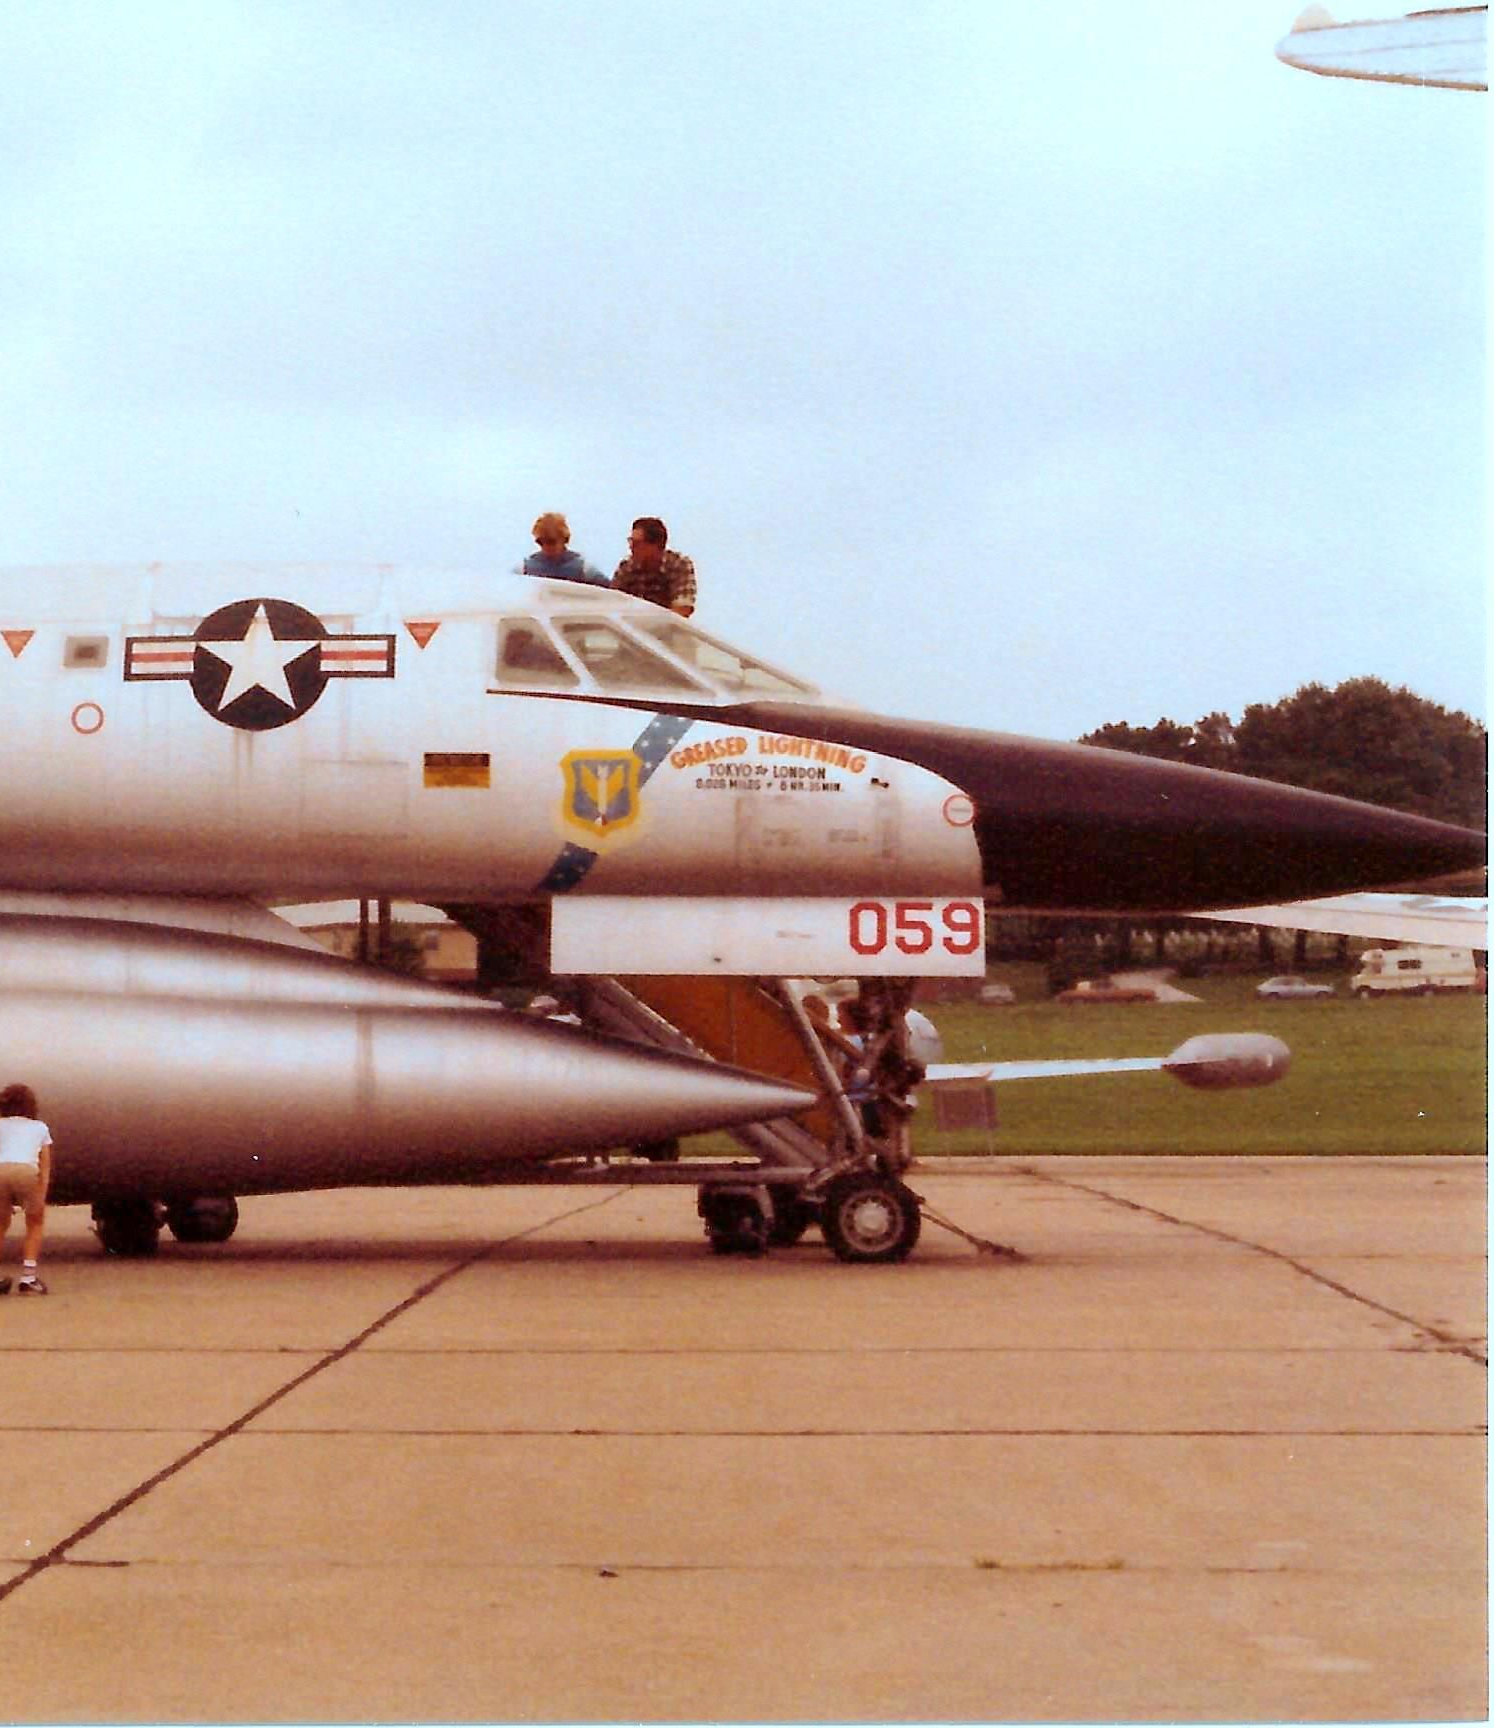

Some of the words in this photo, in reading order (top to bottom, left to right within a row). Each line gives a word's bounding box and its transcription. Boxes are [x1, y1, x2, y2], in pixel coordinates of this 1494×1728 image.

[670, 737, 748, 769] GREASED
[759, 736, 867, 773] LIGHTNING
[708, 763, 752, 779] TOKYO
[773, 765, 826, 780] LONDON
[849, 902, 980, 955] 059
